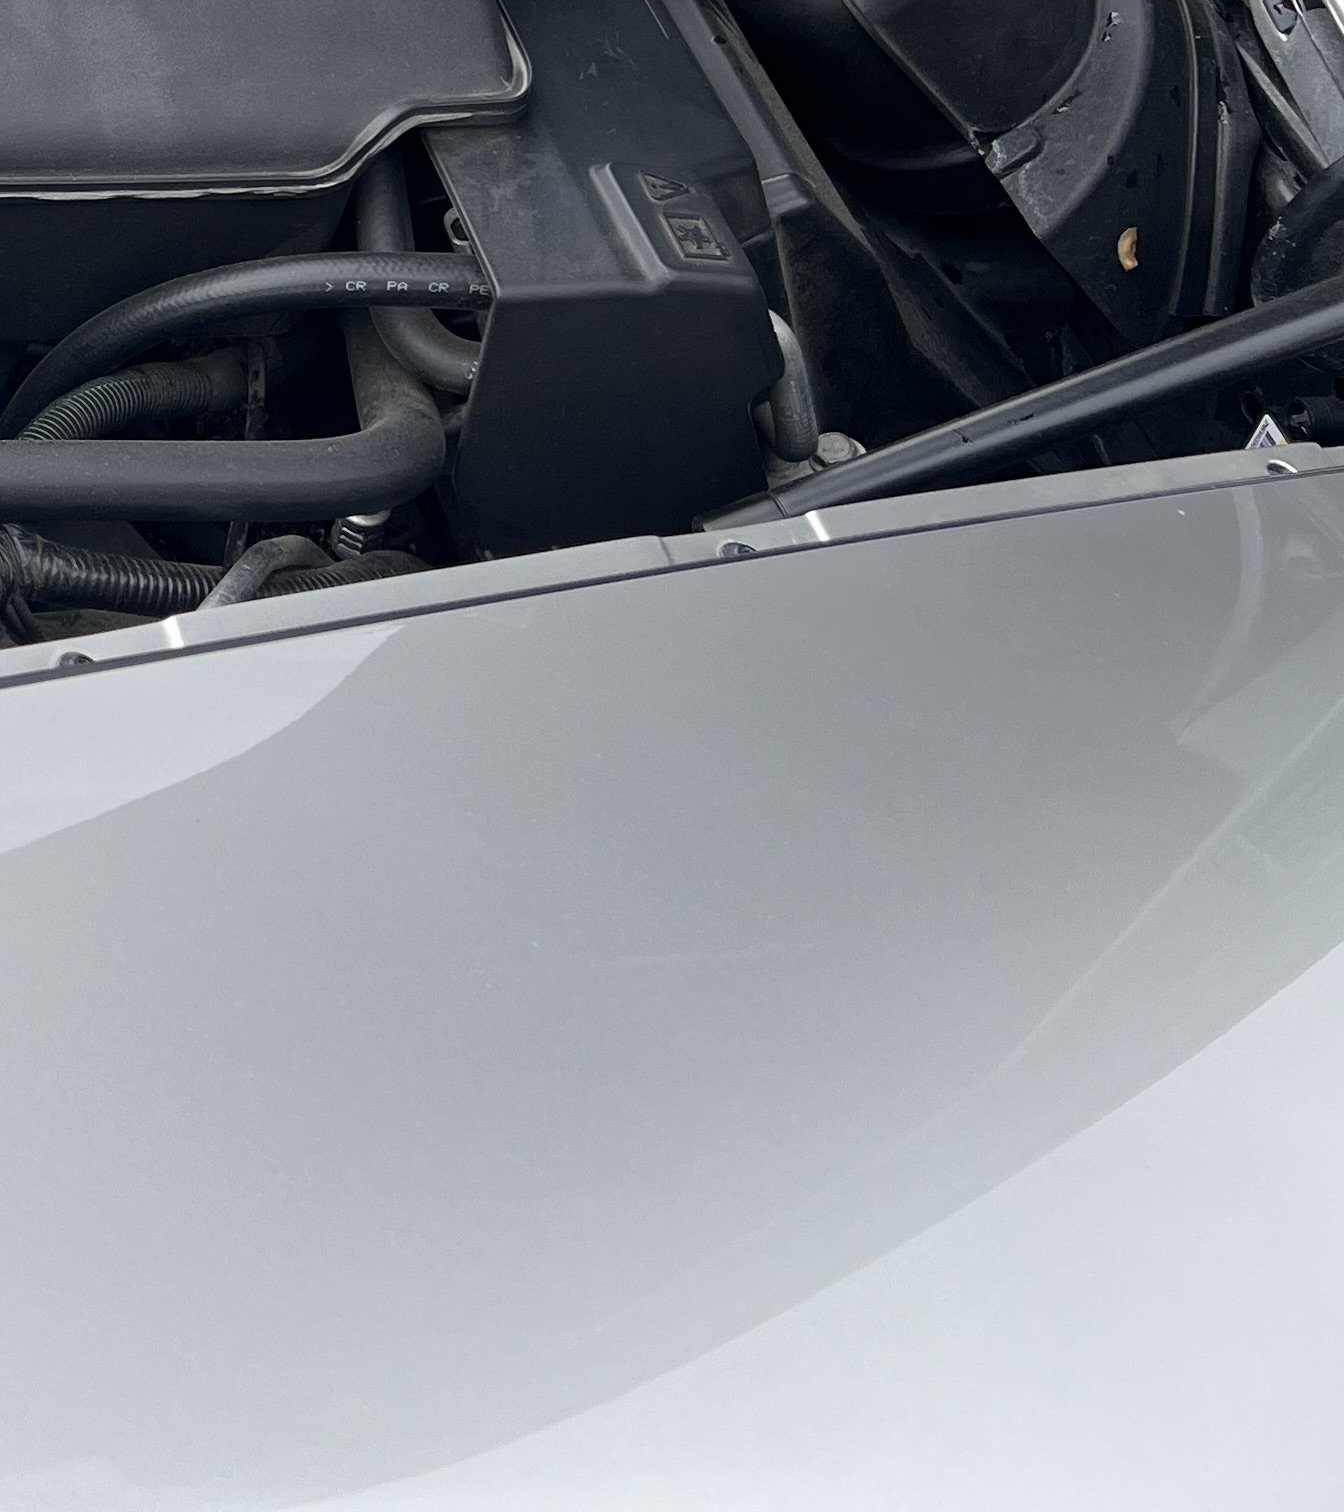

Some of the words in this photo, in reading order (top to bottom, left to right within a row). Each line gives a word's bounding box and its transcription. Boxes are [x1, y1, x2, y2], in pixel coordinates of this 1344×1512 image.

[345, 280, 367, 292] CR
[386, 280, 408, 292] PA
[428, 282, 449, 293] CR
